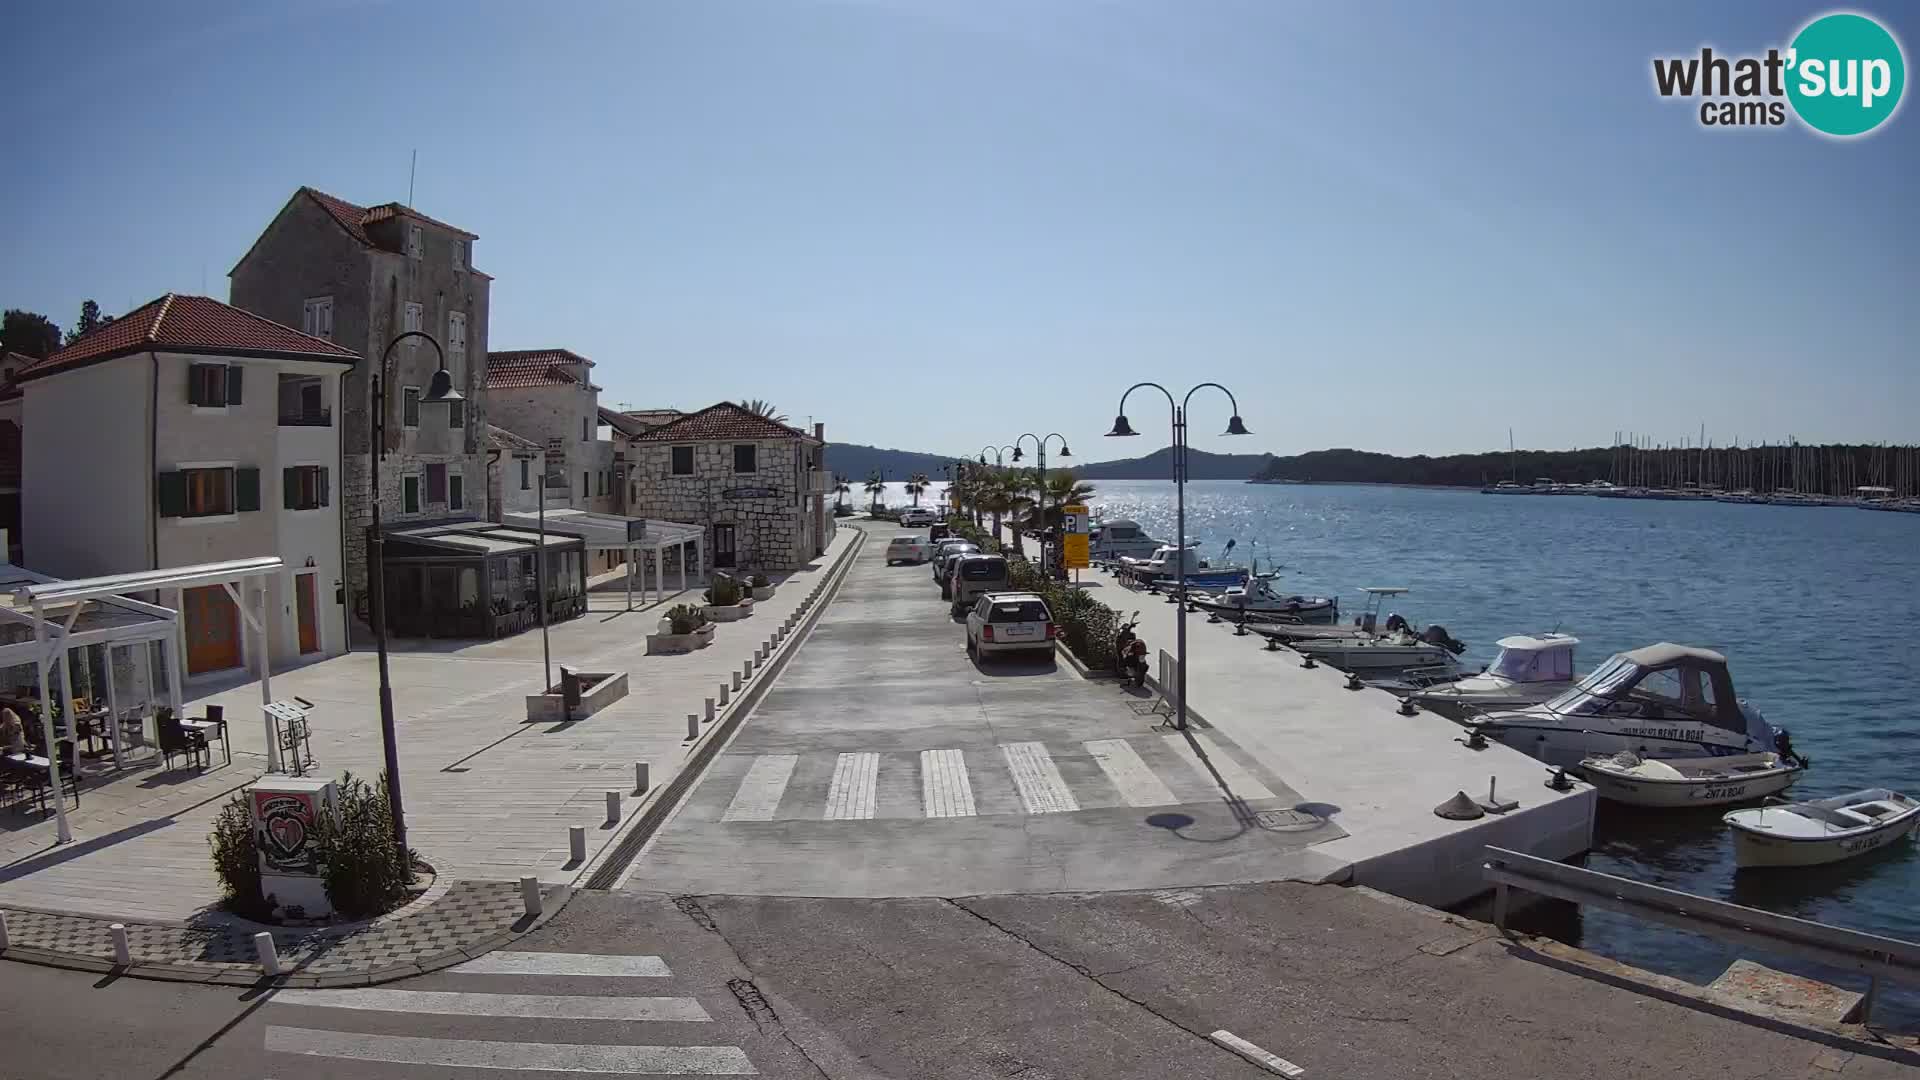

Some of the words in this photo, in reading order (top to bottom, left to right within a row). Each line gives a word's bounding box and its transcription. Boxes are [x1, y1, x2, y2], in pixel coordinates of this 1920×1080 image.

[1065, 515, 1076, 532] P
[1658, 728, 1678, 740] RENT
[1679, 729, 1685, 740] A
[1686, 729, 1705, 741] BOAT
